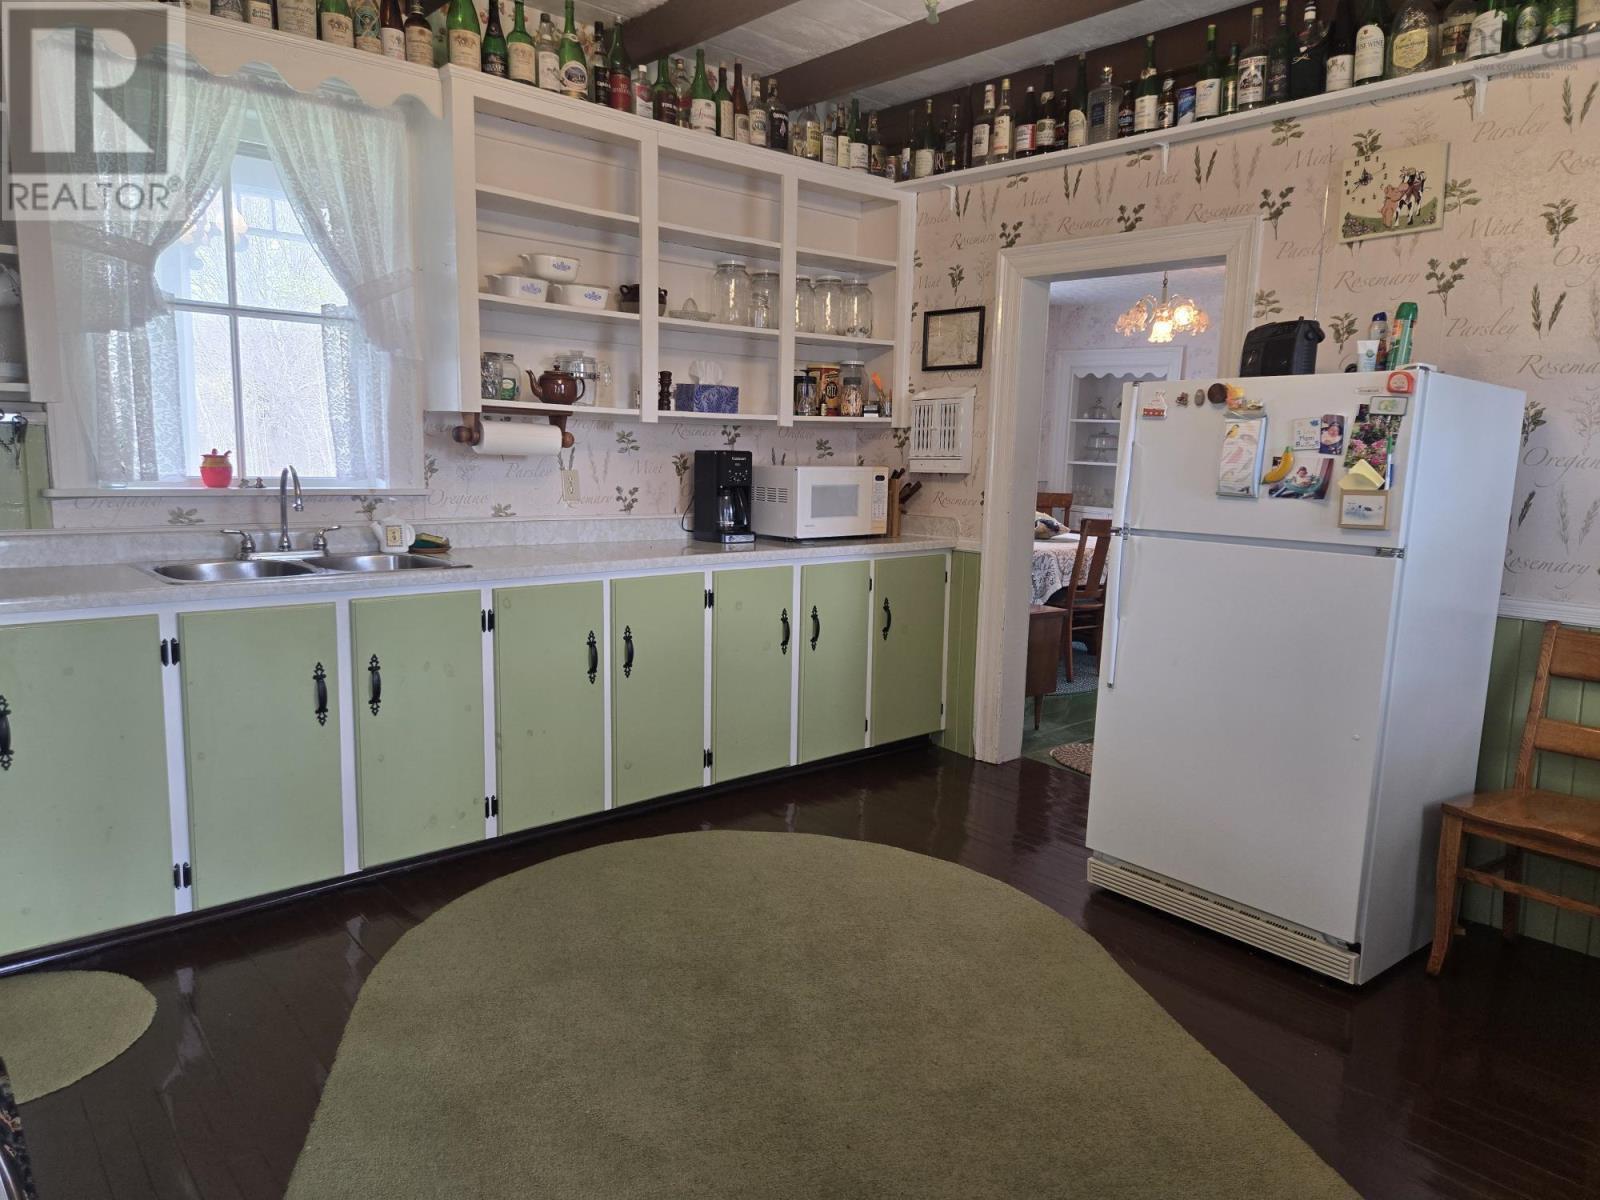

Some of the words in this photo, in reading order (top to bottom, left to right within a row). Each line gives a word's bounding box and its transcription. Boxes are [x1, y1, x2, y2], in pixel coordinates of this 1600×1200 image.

[1457, 215, 1524, 240] Mint
[1334, 268, 1421, 298] Rosemary
[1446, 306, 1519, 350] Parsley
